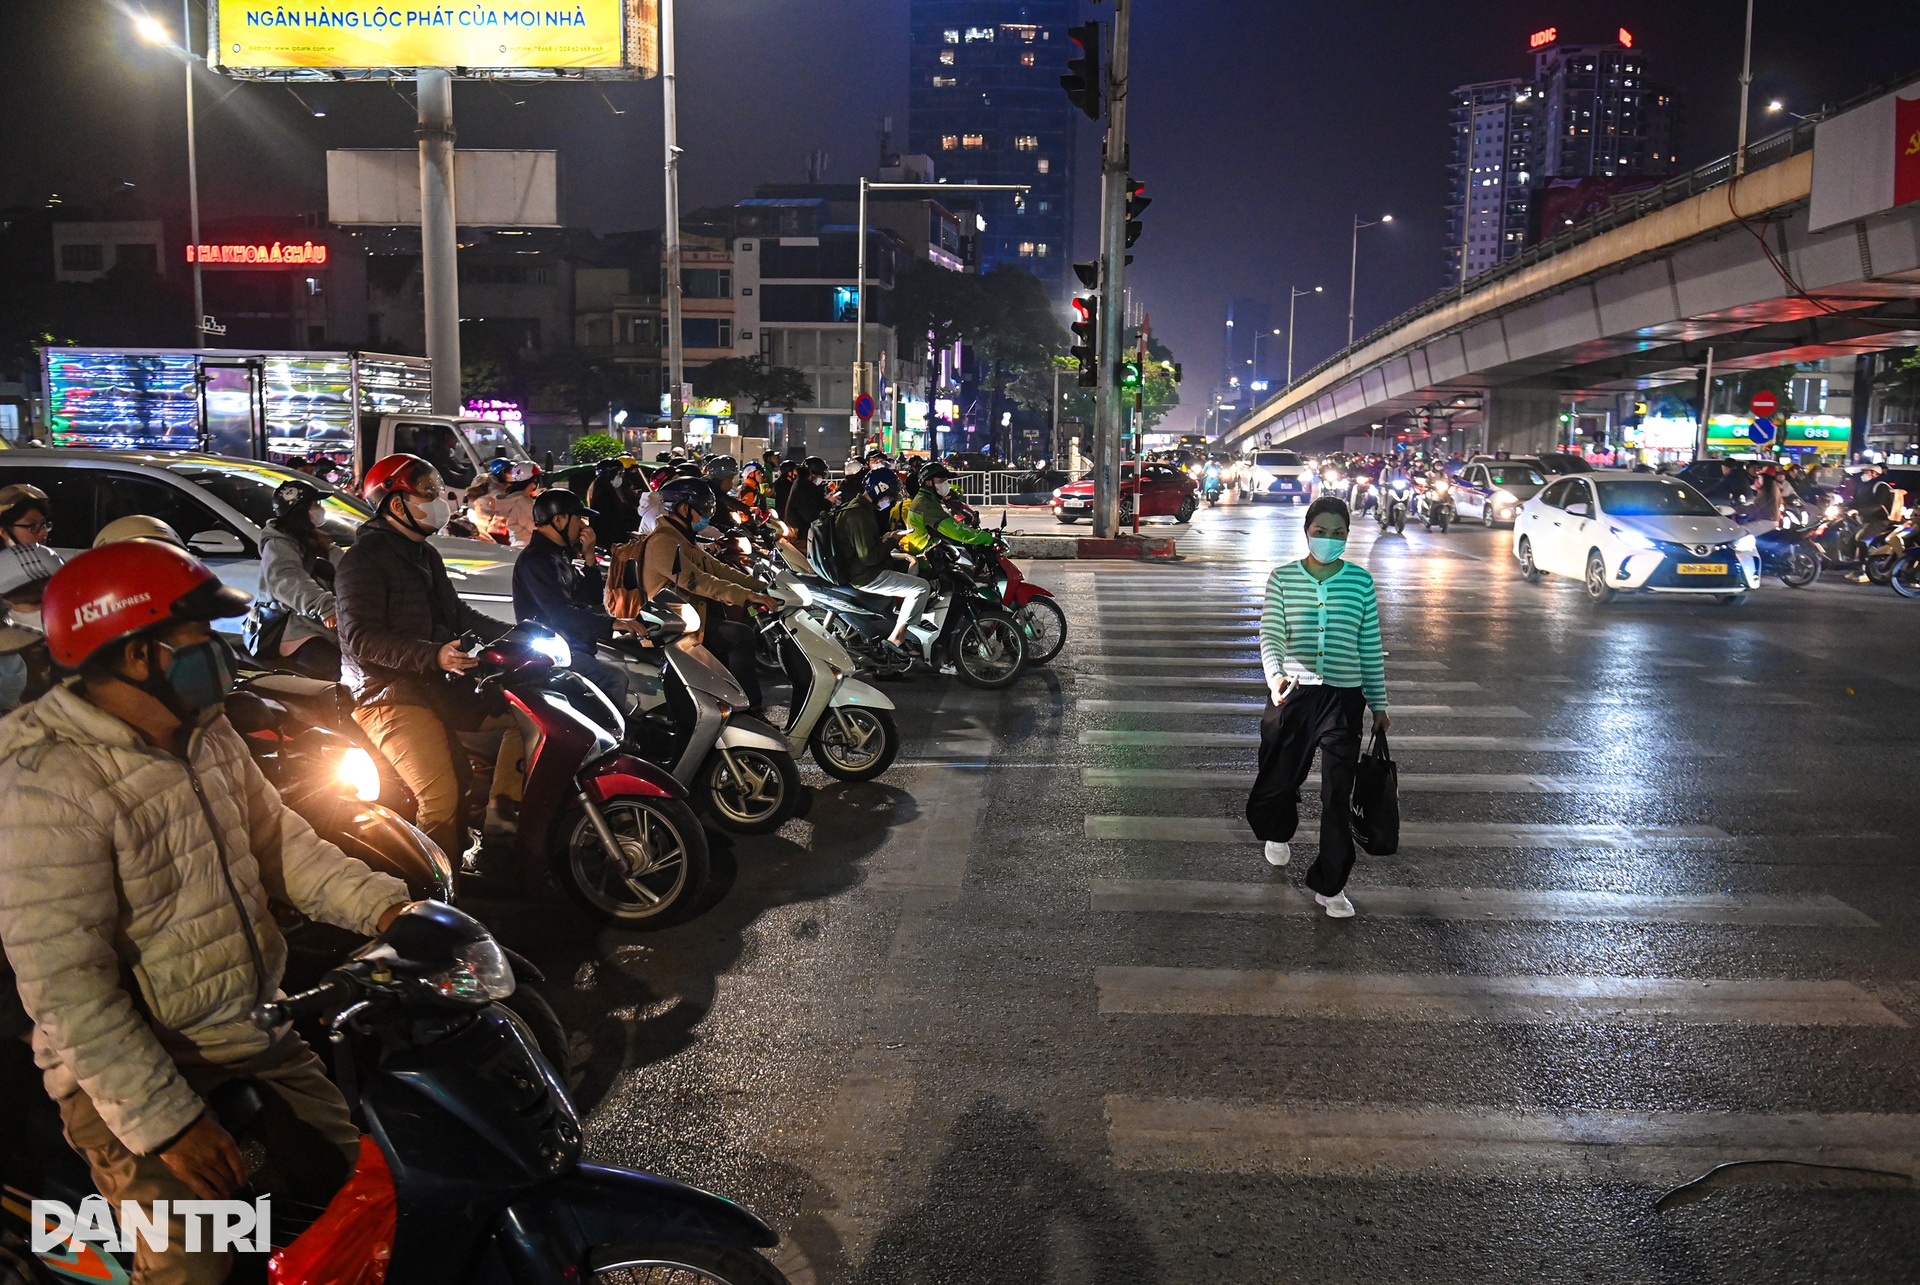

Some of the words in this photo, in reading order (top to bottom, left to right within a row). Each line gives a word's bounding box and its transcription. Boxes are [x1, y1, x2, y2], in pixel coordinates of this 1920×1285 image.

[247, 6, 300, 27] NGÂN
[305, 6, 359, 27] HÀNG
[363, 6, 402, 32] LỘC
[407, 5, 454, 27] PHÁT
[458, 4, 498, 27] CỦA
[503, 11, 541, 31] MỌI
[545, 5, 586, 27] NHÀ
[1530, 27, 1557, 47] UDIC
[71, 592, 117, 631] J&T
[110, 592, 151, 612] EXPRESS
